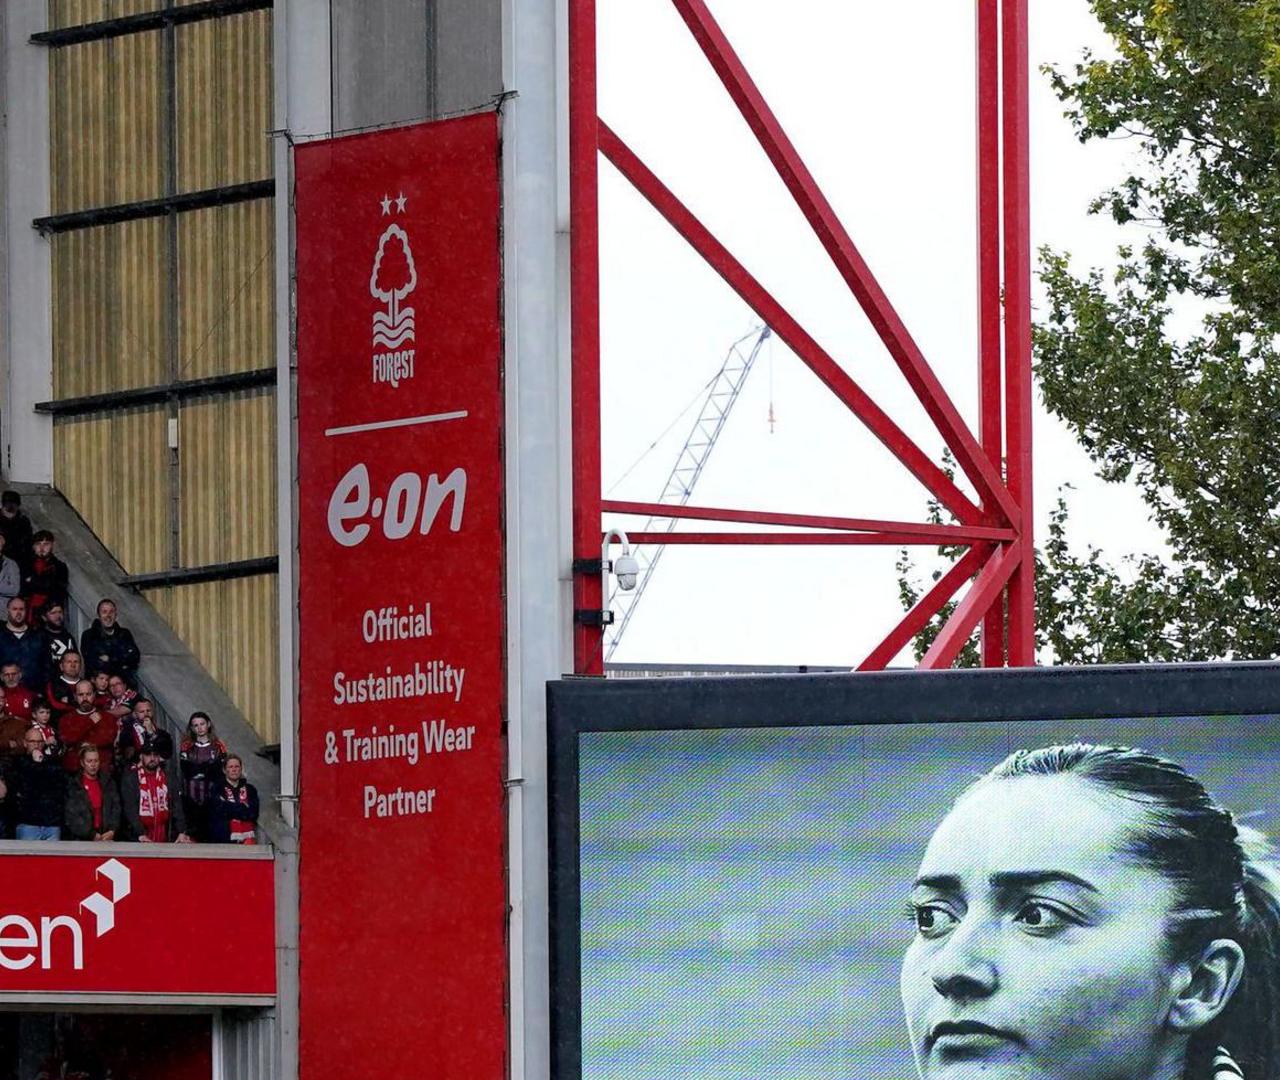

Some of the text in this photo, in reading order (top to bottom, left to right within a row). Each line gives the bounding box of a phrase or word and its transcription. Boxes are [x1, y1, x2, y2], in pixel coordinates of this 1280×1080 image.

[362, 602, 432, 644] Official
[334, 660, 466, 705] Sustainability
[324, 720, 476, 766] & Training Wear
[363, 786, 436, 818] Partner
